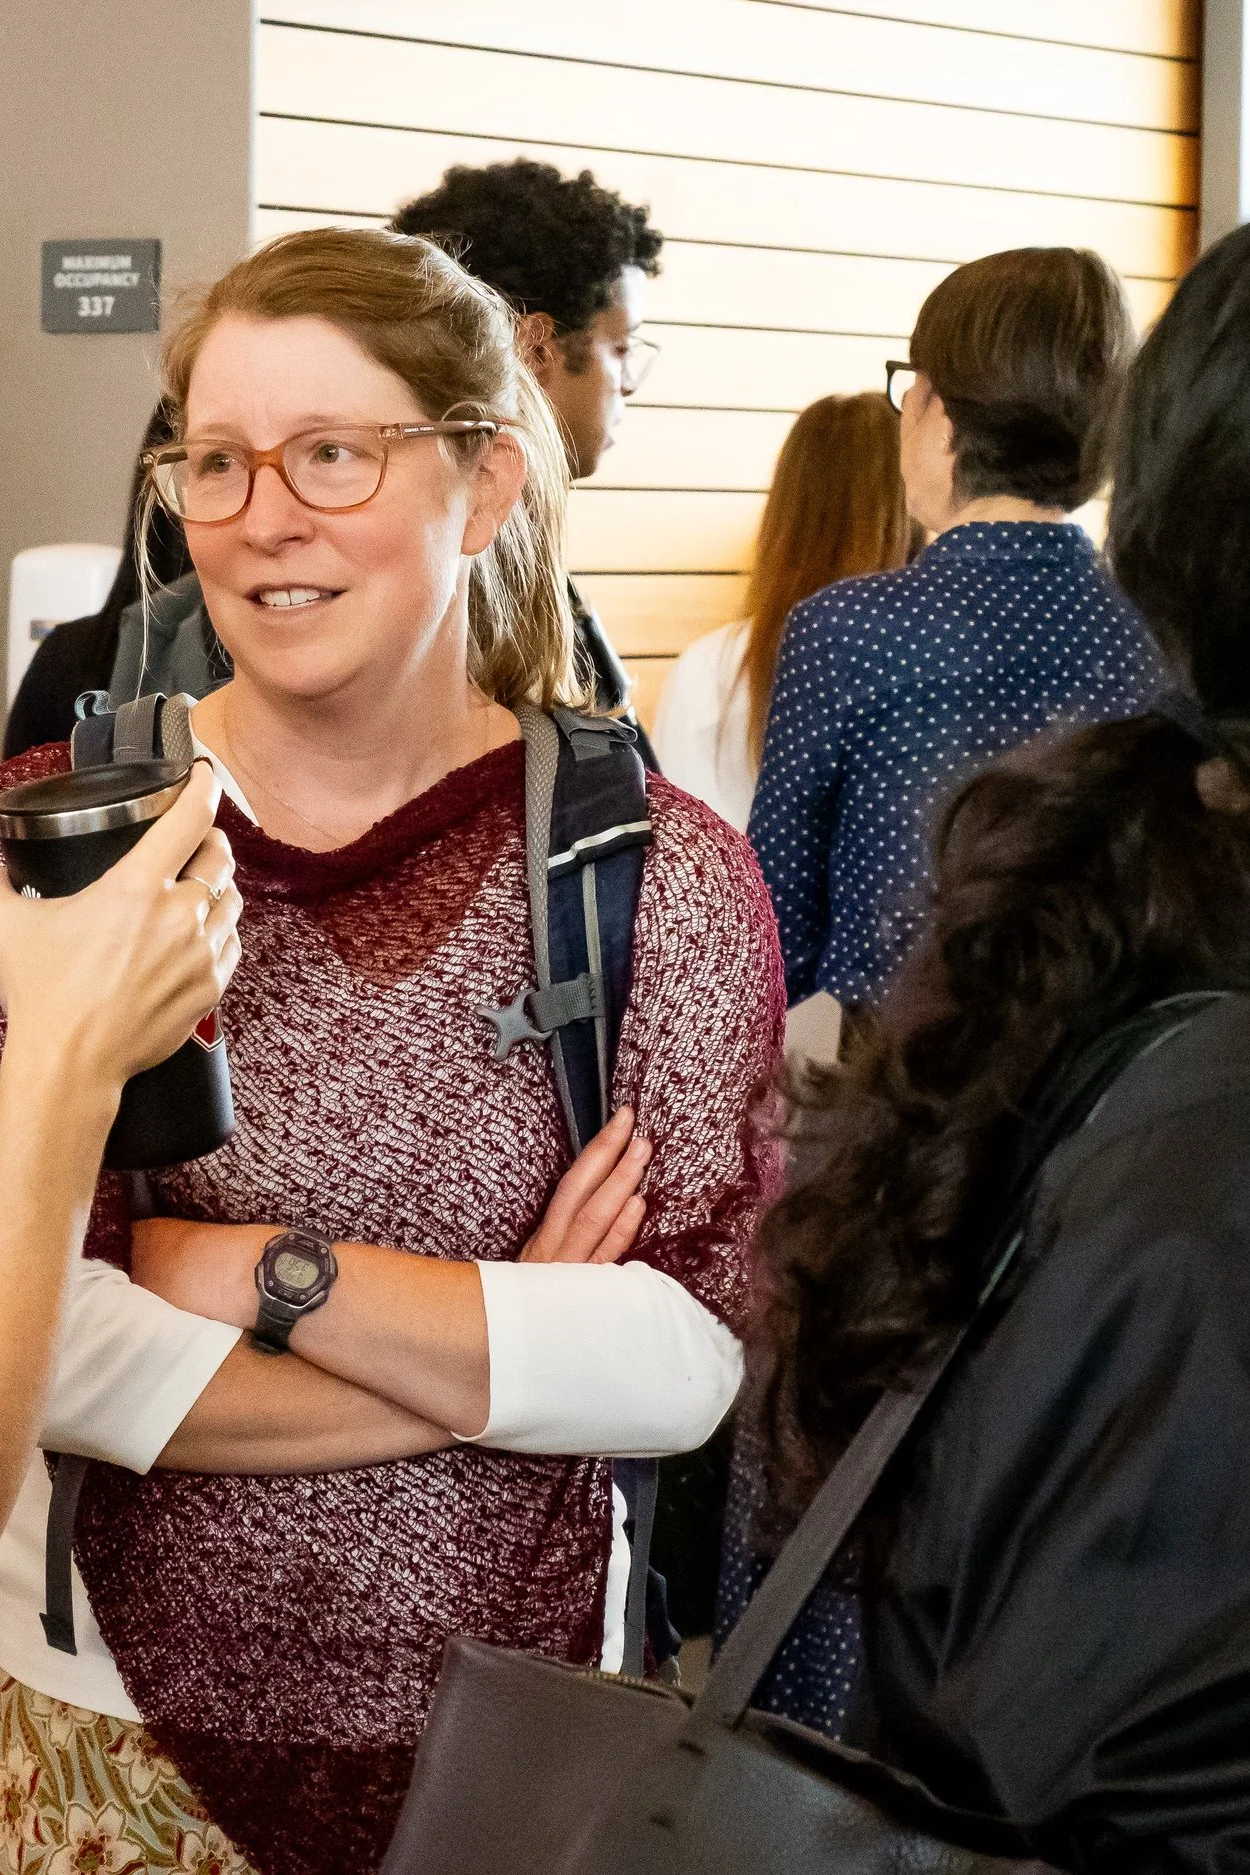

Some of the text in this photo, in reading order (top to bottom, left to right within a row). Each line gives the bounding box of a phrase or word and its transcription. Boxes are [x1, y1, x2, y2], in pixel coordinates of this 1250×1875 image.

[61, 254, 132, 271] MAXIMUM
[53, 272, 141, 289] OCCUPANCY
[78, 295, 115, 317] 337
